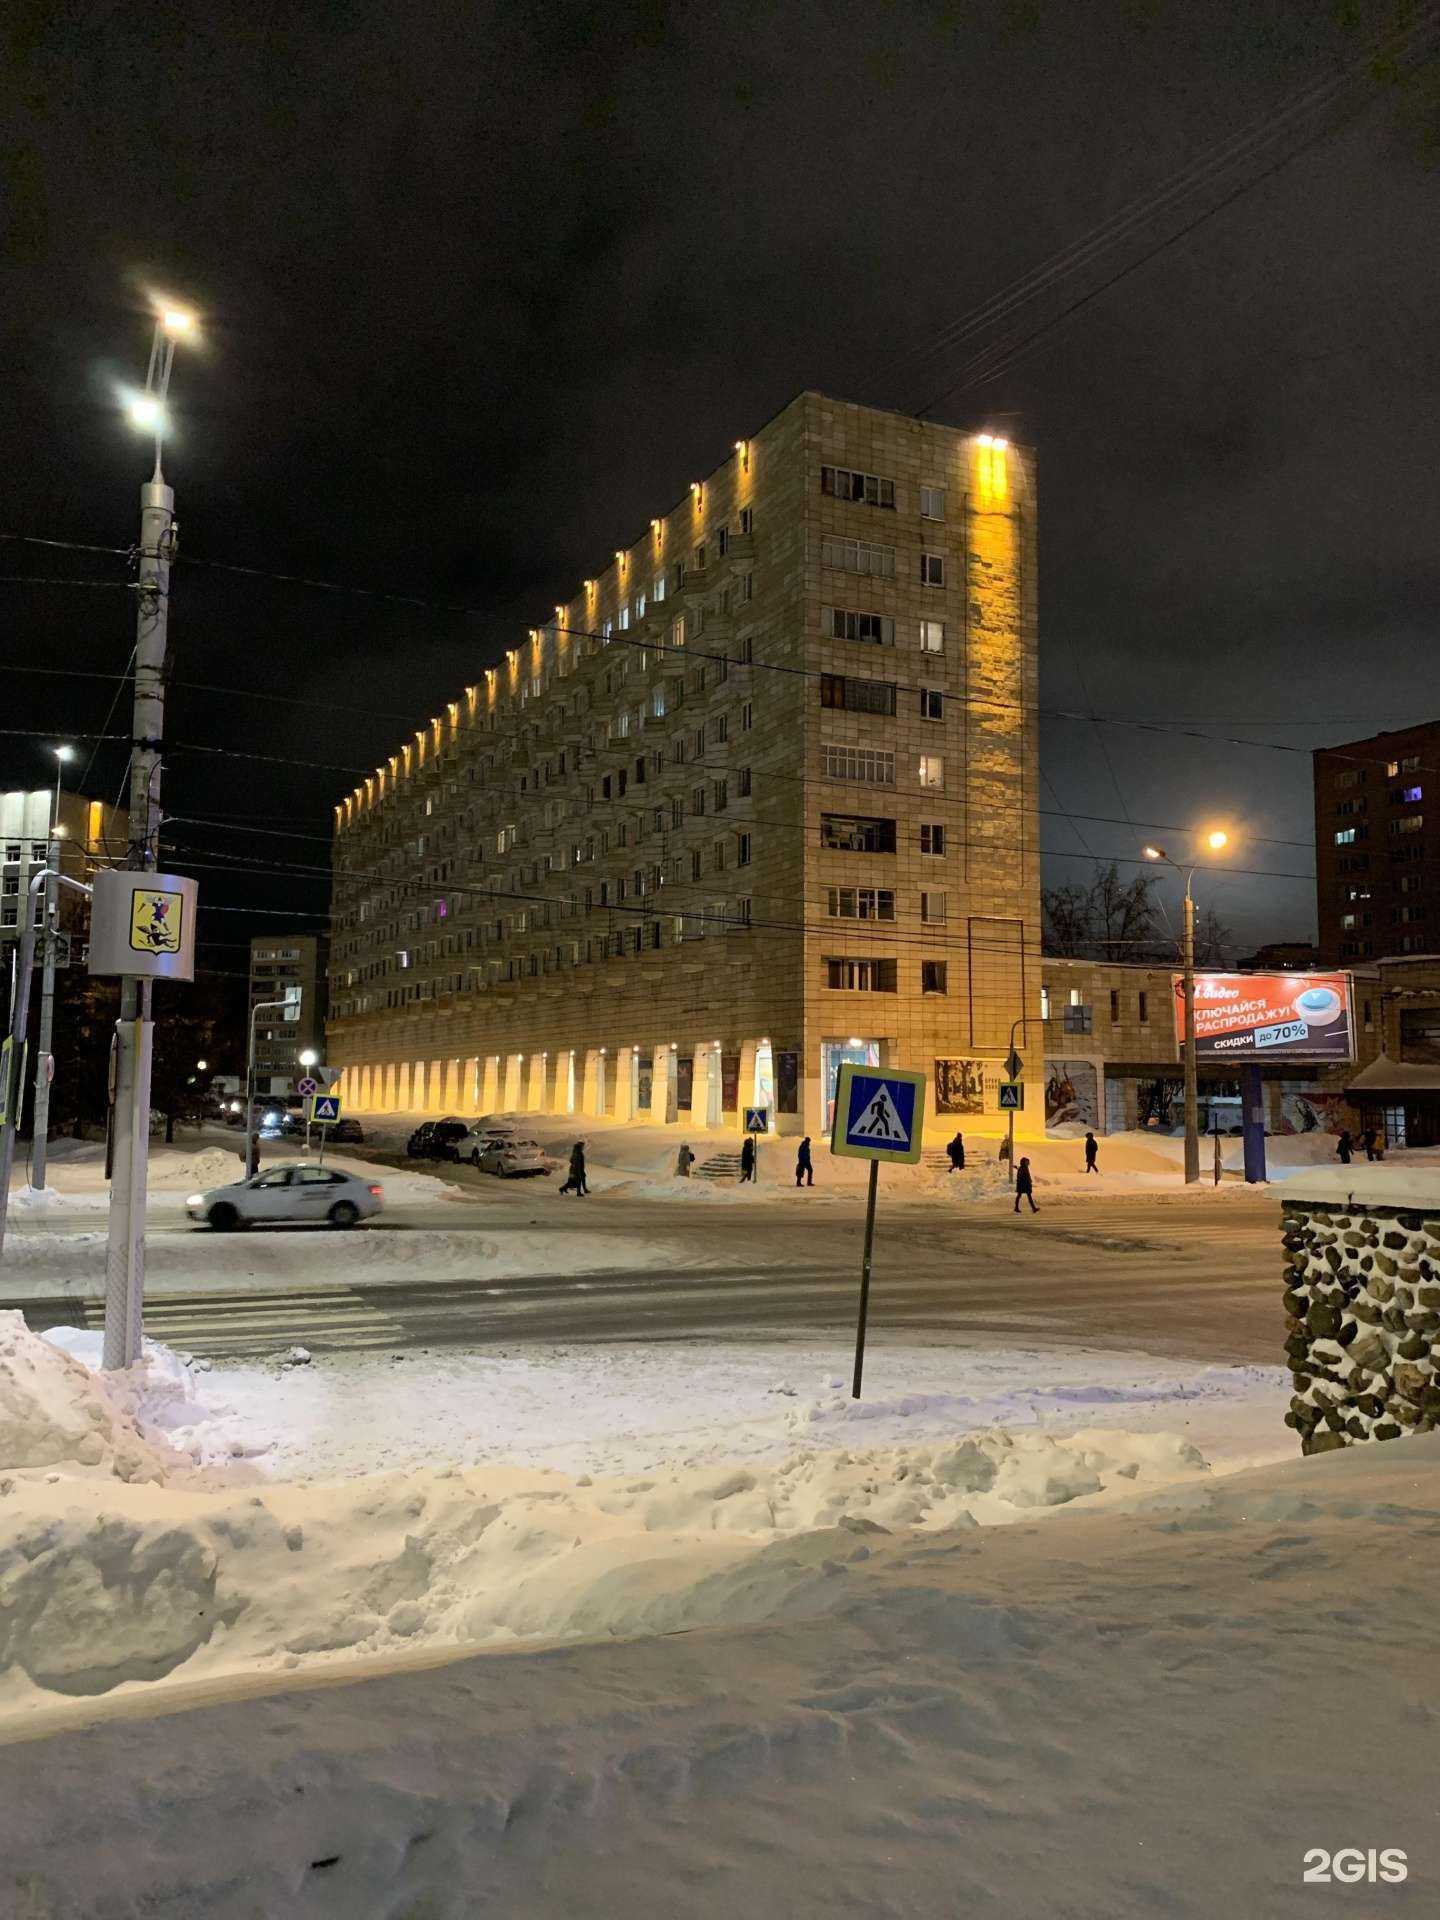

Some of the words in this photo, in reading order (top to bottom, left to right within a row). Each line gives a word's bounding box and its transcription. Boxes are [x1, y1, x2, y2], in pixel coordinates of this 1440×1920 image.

[1193, 999, 1266, 1021] КЛЮЧАЙСЯ
[1195, 1006, 1290, 1033] РАСПРОДАЖУ!
[1259, 1032, 1272, 1042] до
[1273, 1023, 1306, 1041] 70%
